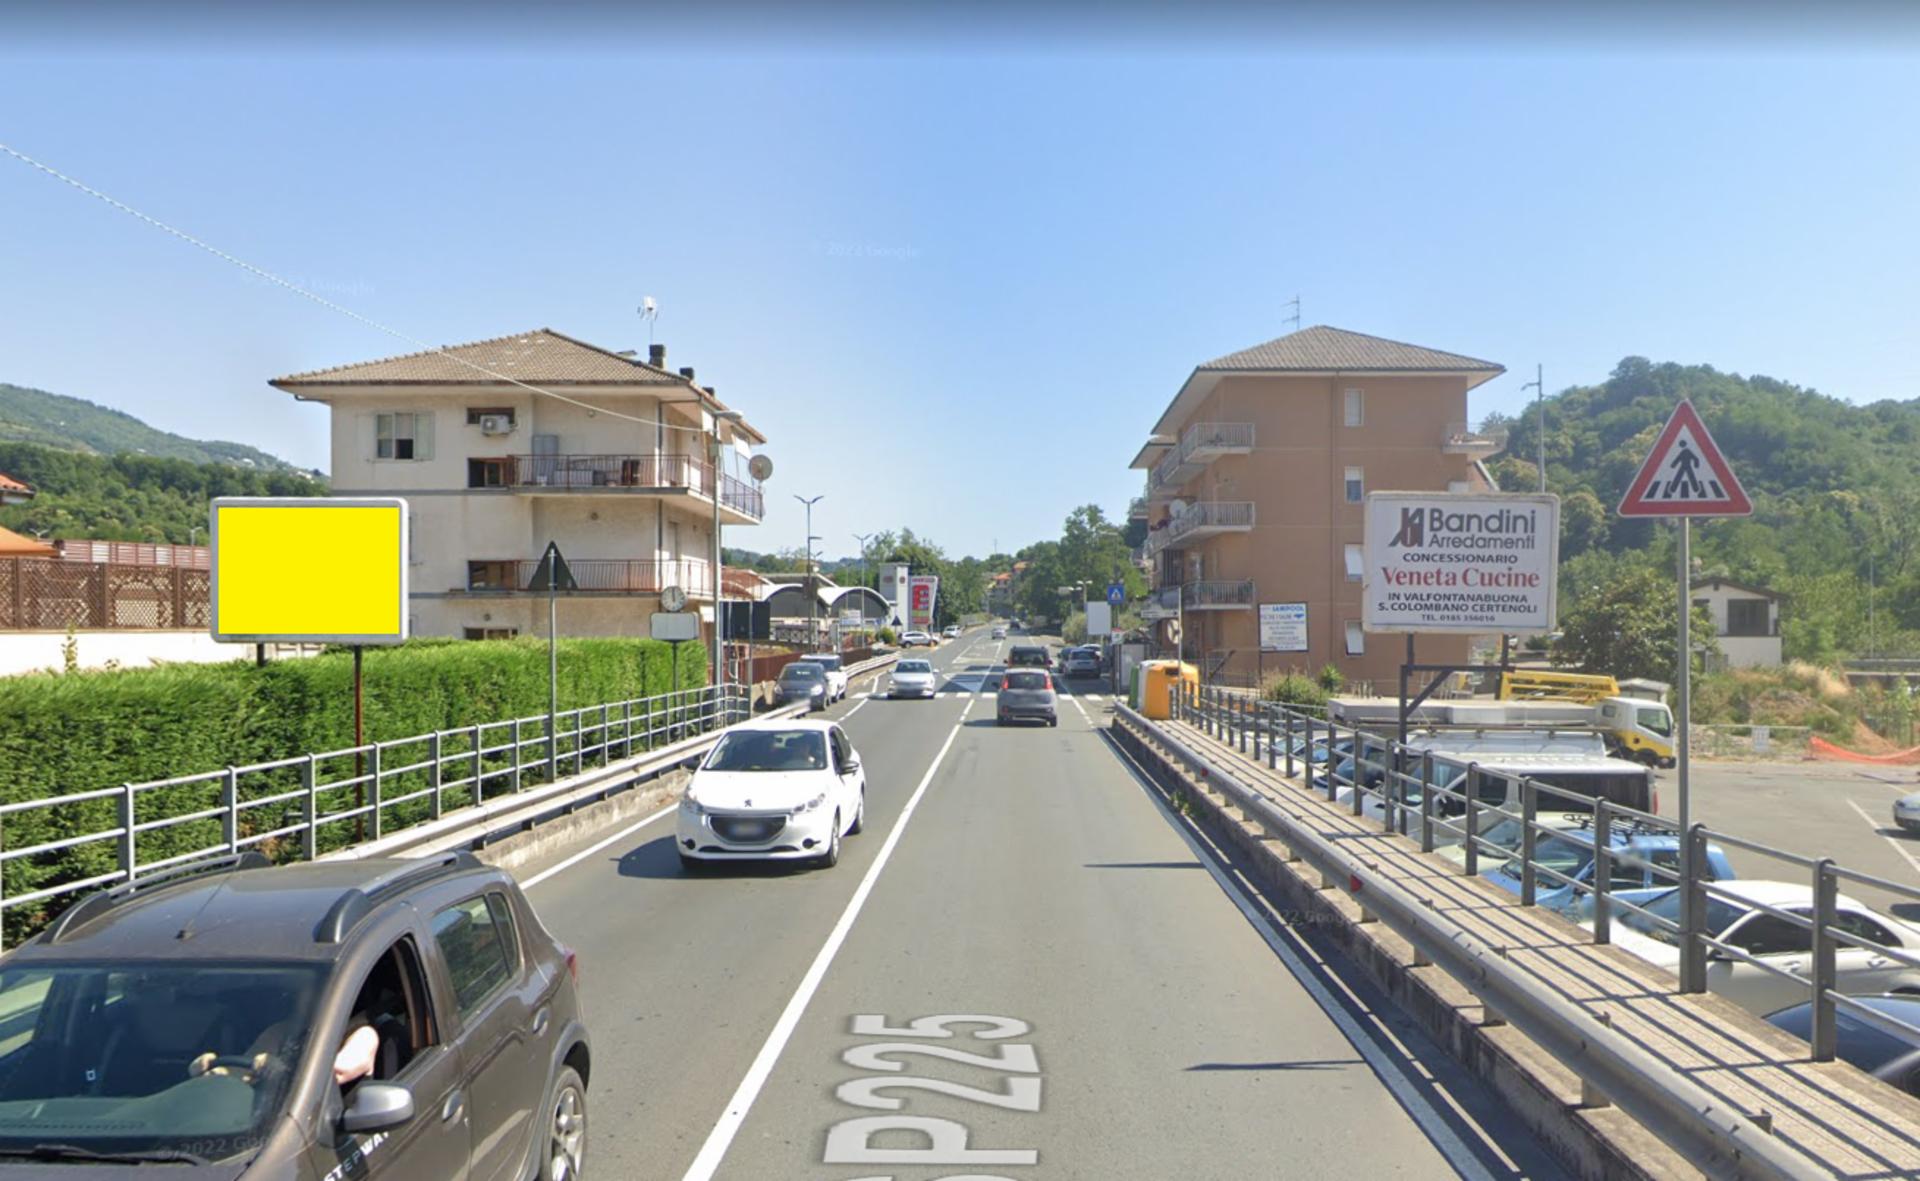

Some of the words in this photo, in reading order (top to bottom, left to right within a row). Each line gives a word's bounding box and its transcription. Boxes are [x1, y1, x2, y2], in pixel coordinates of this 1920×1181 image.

[1429, 508, 1537, 534] Bandini
[1428, 534, 1535, 549] Arredamenti
[1402, 552, 1518, 564] CONCESSIONARIO
[1381, 566, 1457, 586] Veneta
[1461, 567, 1540, 588] Cucine
[1388, 592, 1400, 601] IN
[1403, 592, 1528, 603] VALFONTANABUONA
[1378, 602, 1389, 612] S.
[1391, 602, 1469, 613] COLOMBANO
[1471, 603, 1537, 614] CERTENOLI
[323, 1131, 389, 1181] STEPWA
